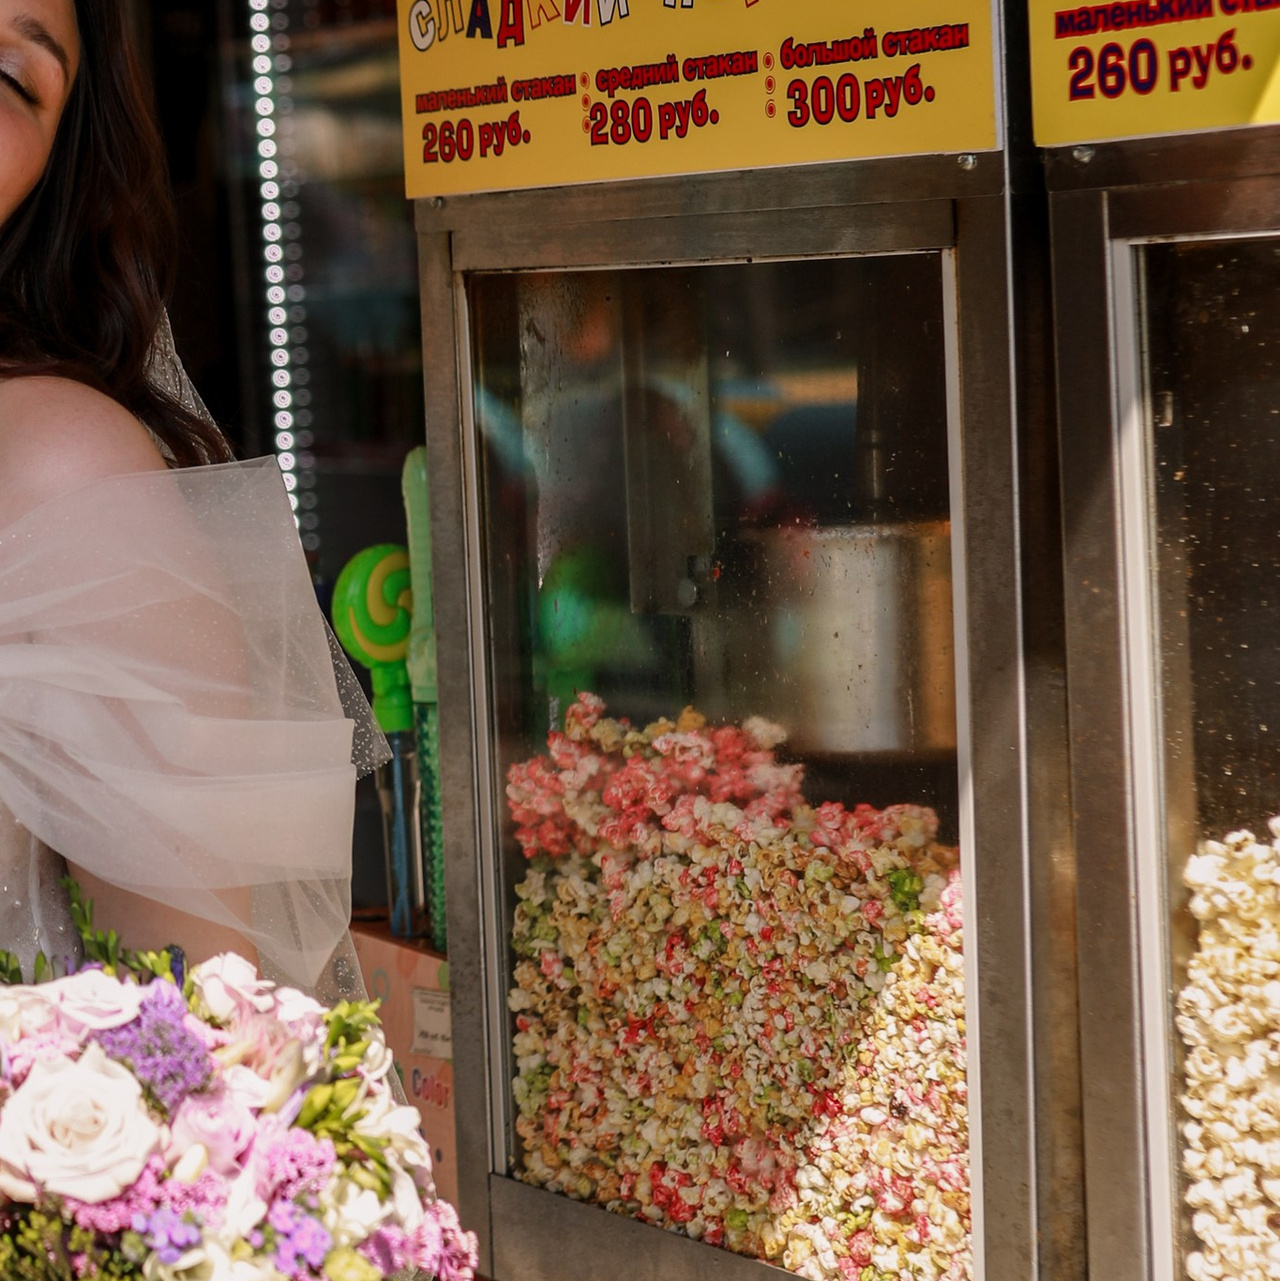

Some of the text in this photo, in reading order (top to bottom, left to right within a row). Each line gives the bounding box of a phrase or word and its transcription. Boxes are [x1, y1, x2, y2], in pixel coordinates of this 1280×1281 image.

[780, 23, 970, 70] большой стакан
[1068, 28, 1253, 101] 260 руб.
[415, 73, 577, 114] маленький стакан
[595, 50, 758, 98] средний стакан
[787, 63, 935, 128] 300 руб.
[422, 110, 531, 163] 260 руб.
[590, 88, 719, 146] 280 руб.
